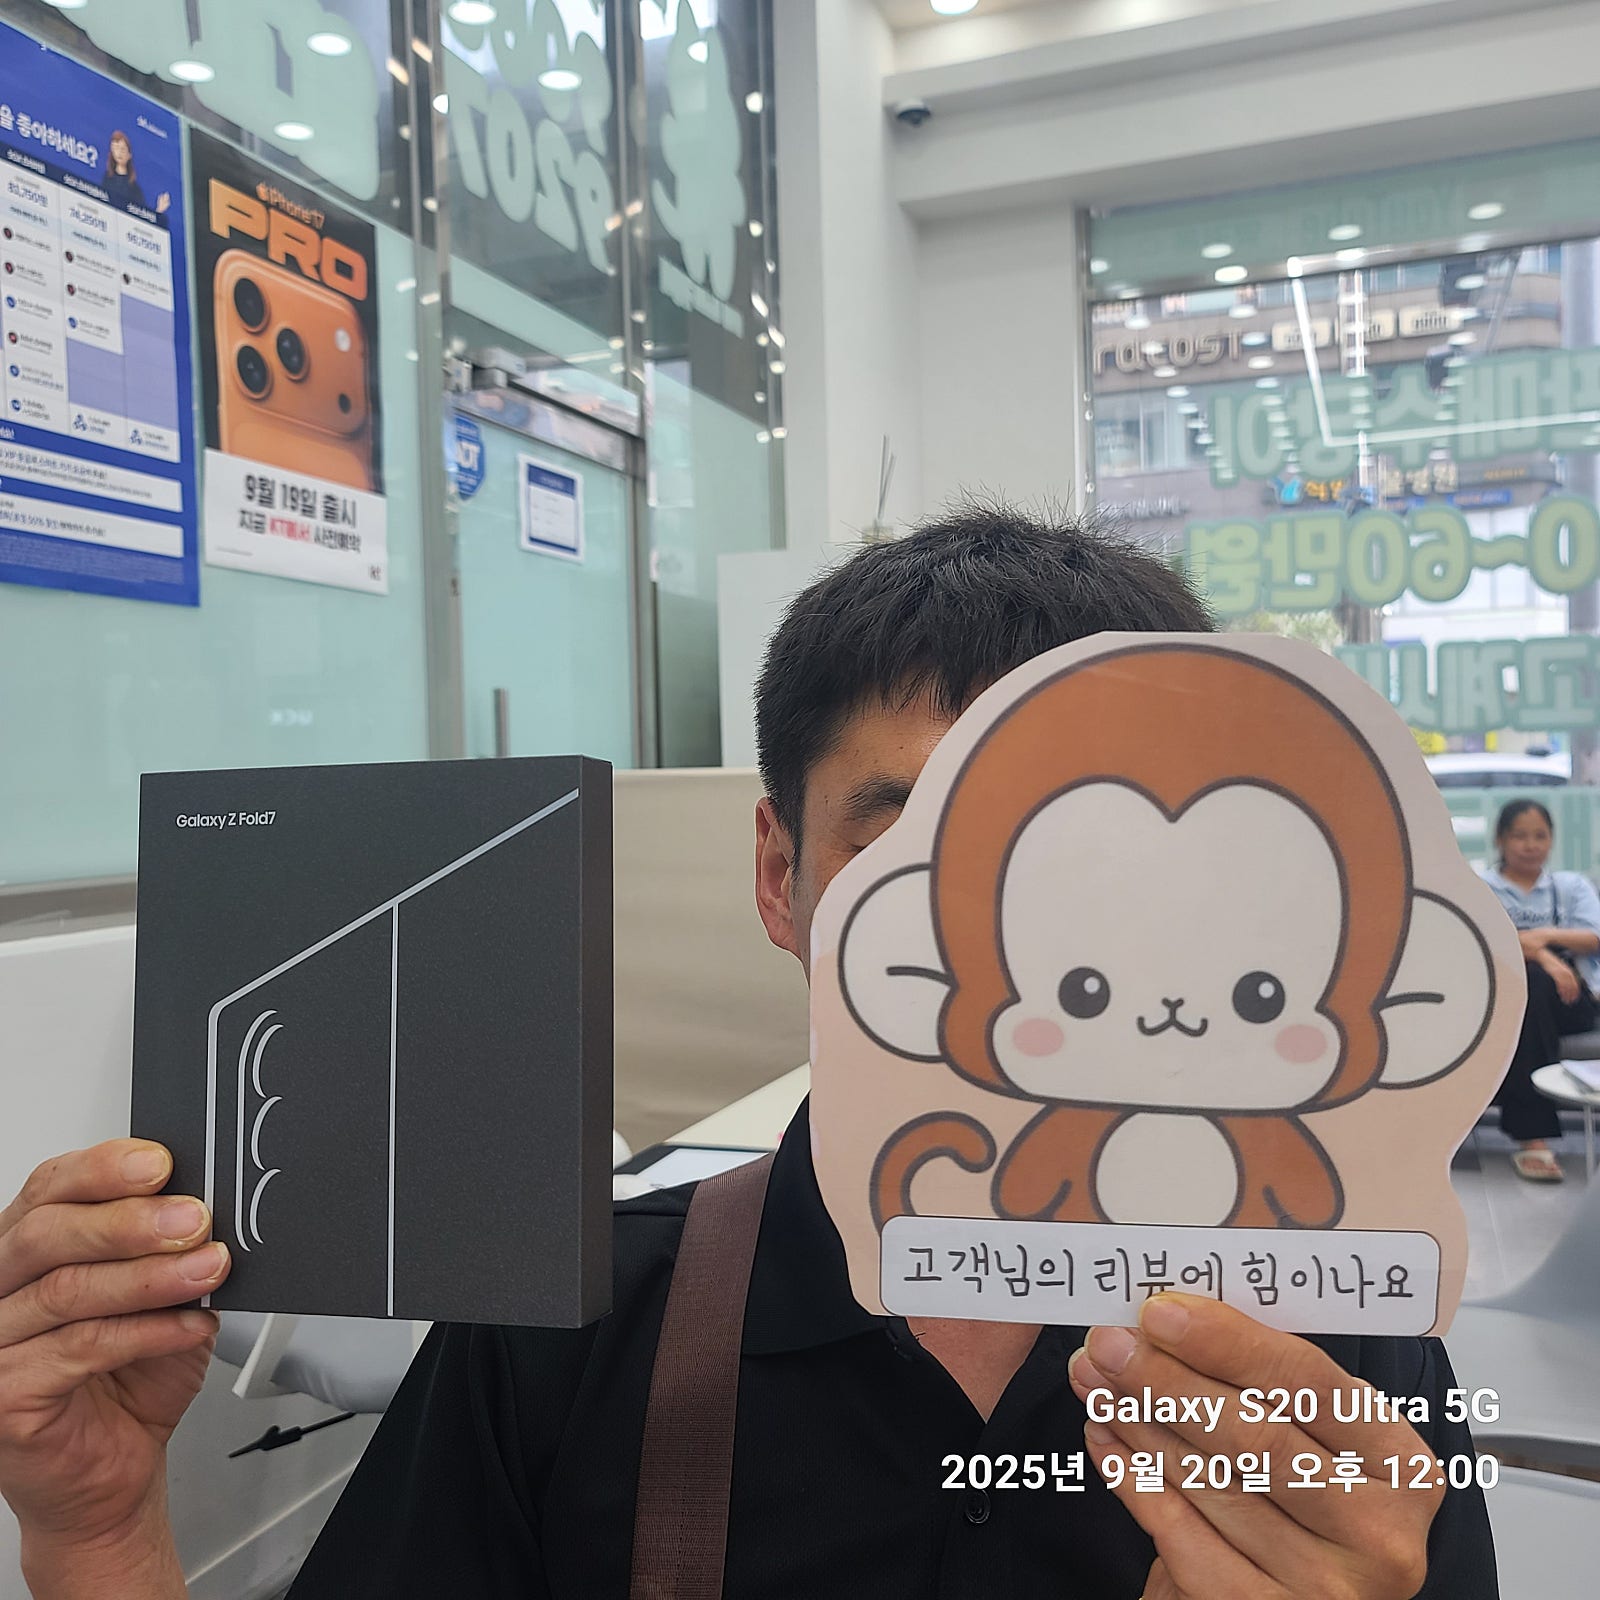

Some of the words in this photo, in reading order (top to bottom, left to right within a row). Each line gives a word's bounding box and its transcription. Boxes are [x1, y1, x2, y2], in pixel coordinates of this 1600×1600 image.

[16, 112, 98, 168] 좋아하세요?
[209, 177, 367, 301] PRO
[245, 474, 275, 509] 9월
[281, 483, 317, 519] 19일
[322, 494, 356, 528] 출시
[239, 508, 266, 534] 지금
[269, 517, 312, 544] KT에서
[313, 527, 361, 553] 사전예약
[176, 813, 227, 830] Galaxy
[228, 812, 237, 826] Z
[238, 811, 276, 826] Fold7
[902, 1242, 1074, 1298] 고객님의
[1093, 1247, 1224, 1302] 리뷰에
